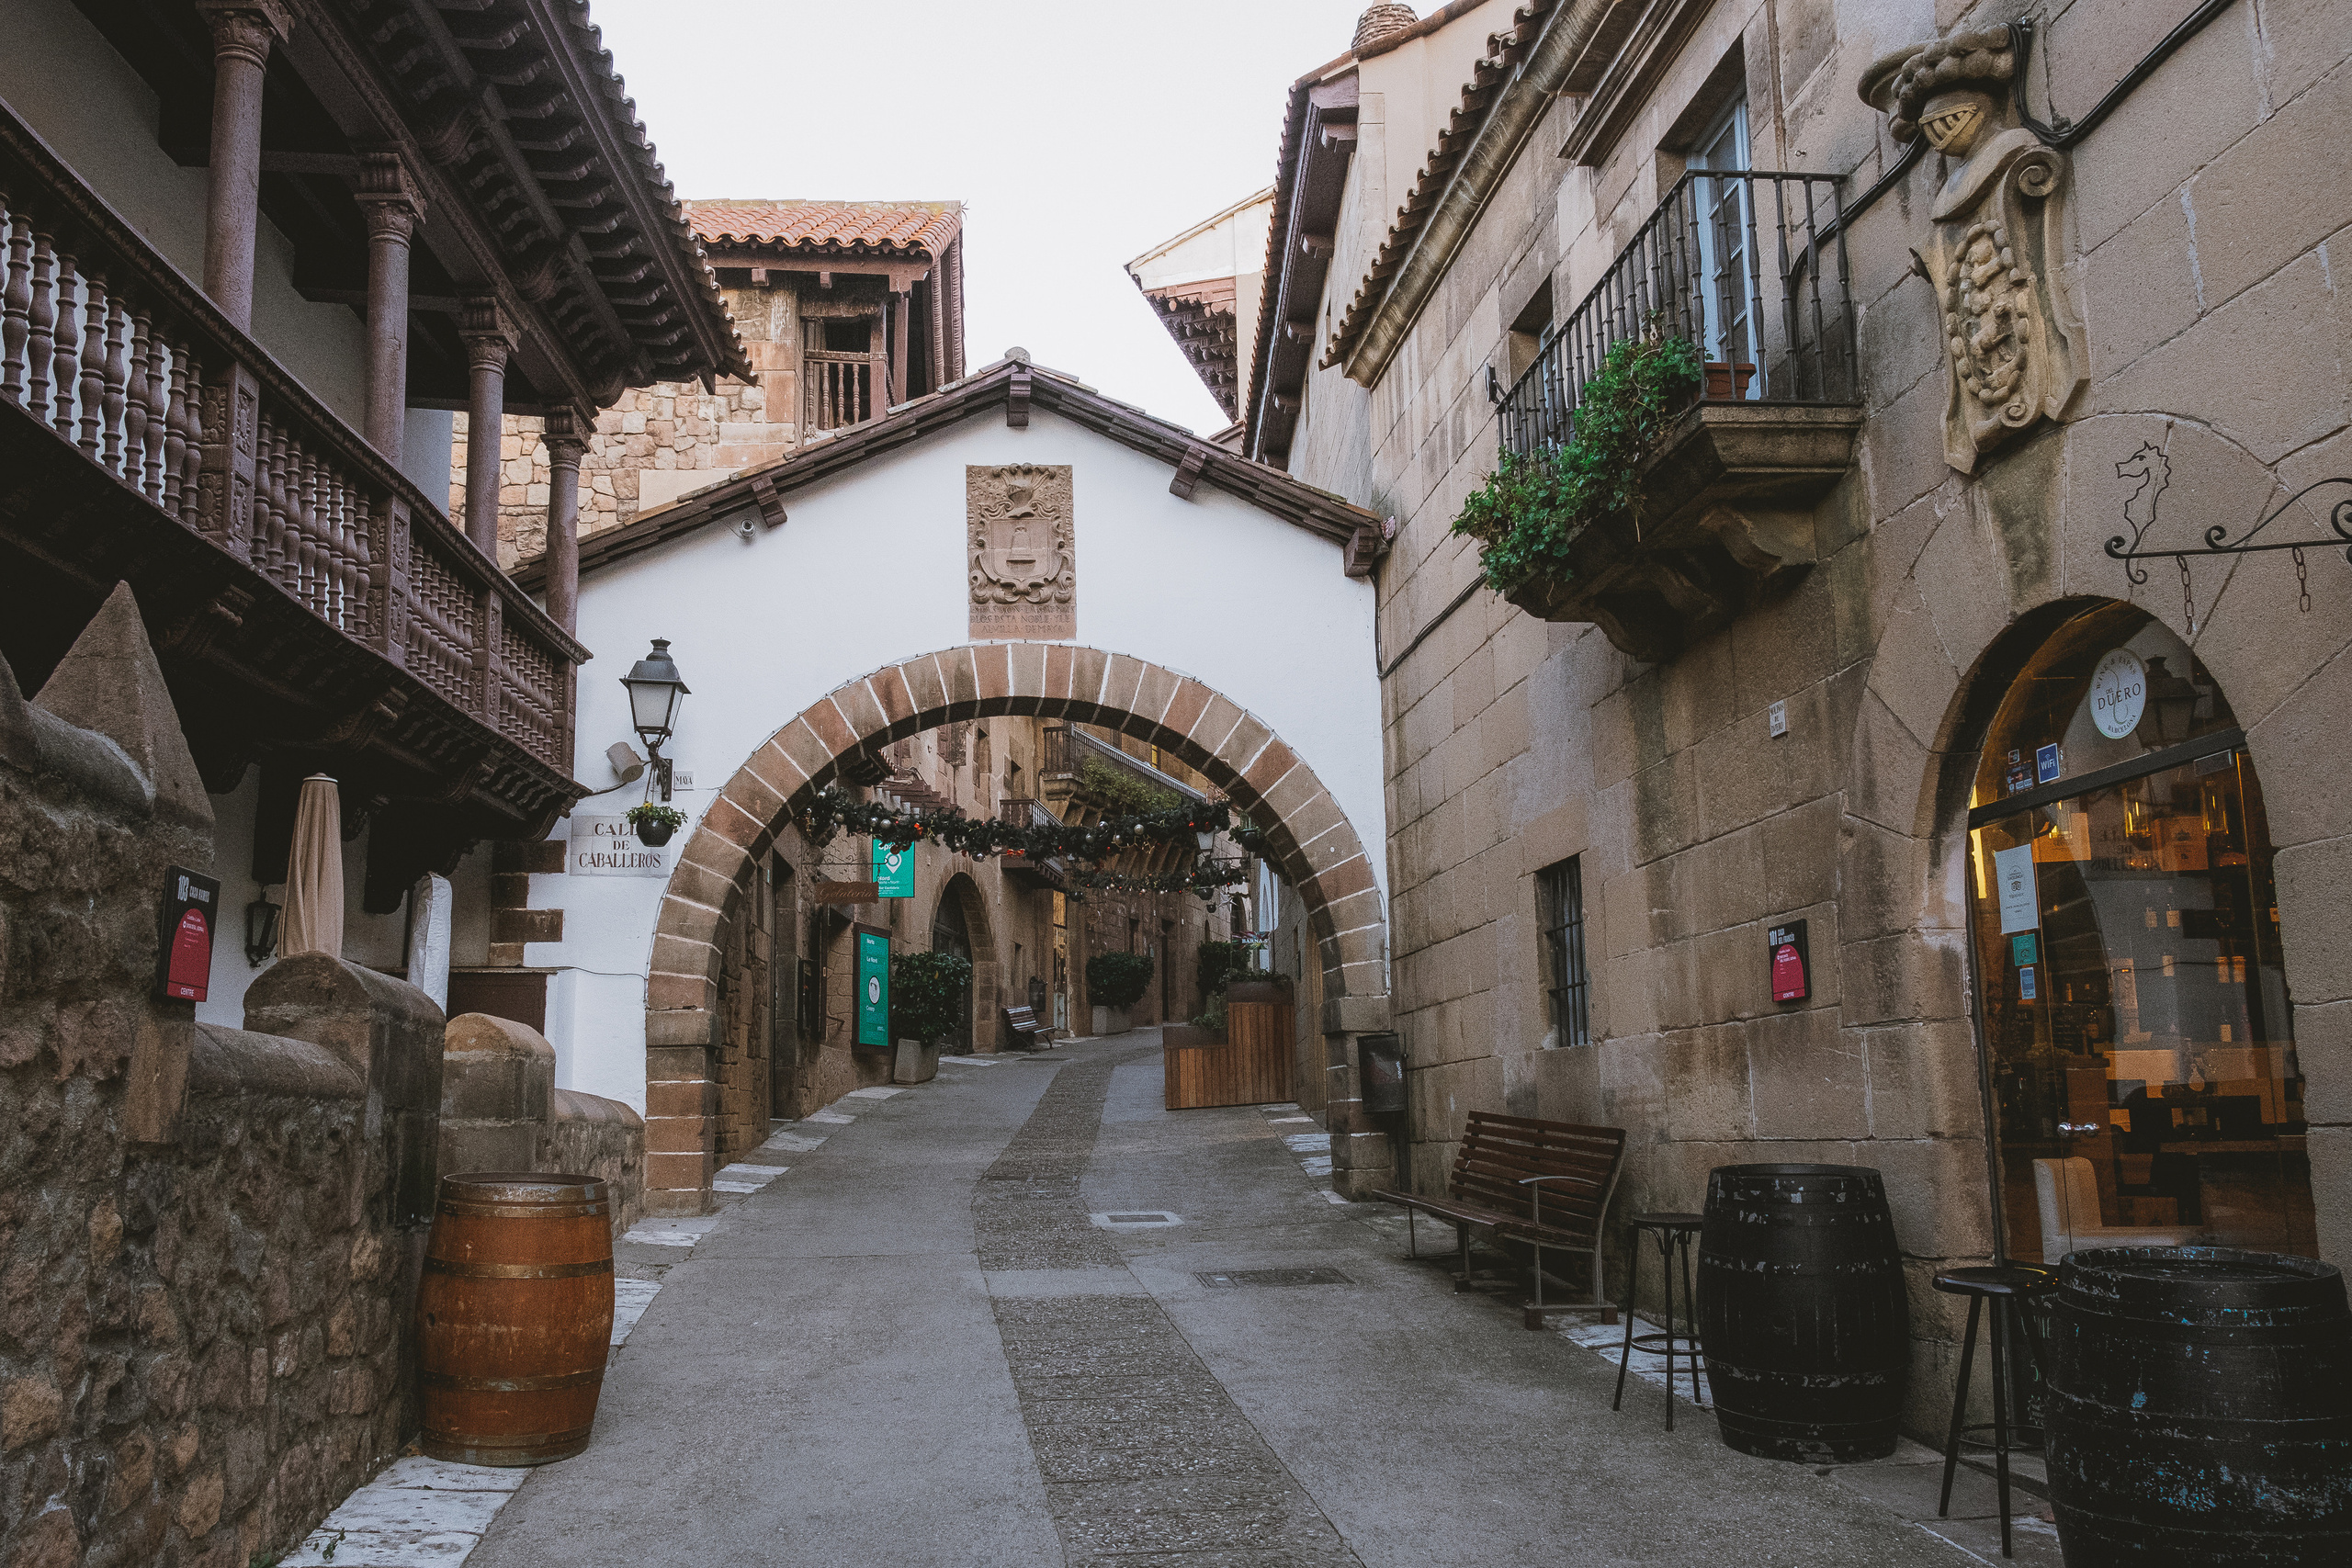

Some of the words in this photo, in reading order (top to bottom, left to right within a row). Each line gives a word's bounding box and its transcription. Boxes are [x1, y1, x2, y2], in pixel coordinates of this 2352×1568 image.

[2098, 682, 2142, 710] DUERO
[2108, 714, 2136, 733] BARCELONA
[675, 775, 693, 785] MAYA
[594, 823, 637, 836] CALL
[613, 840, 630, 850] DE
[579, 852, 662, 868] CABALLEROS
[181, 987, 194, 997] CENTRE
